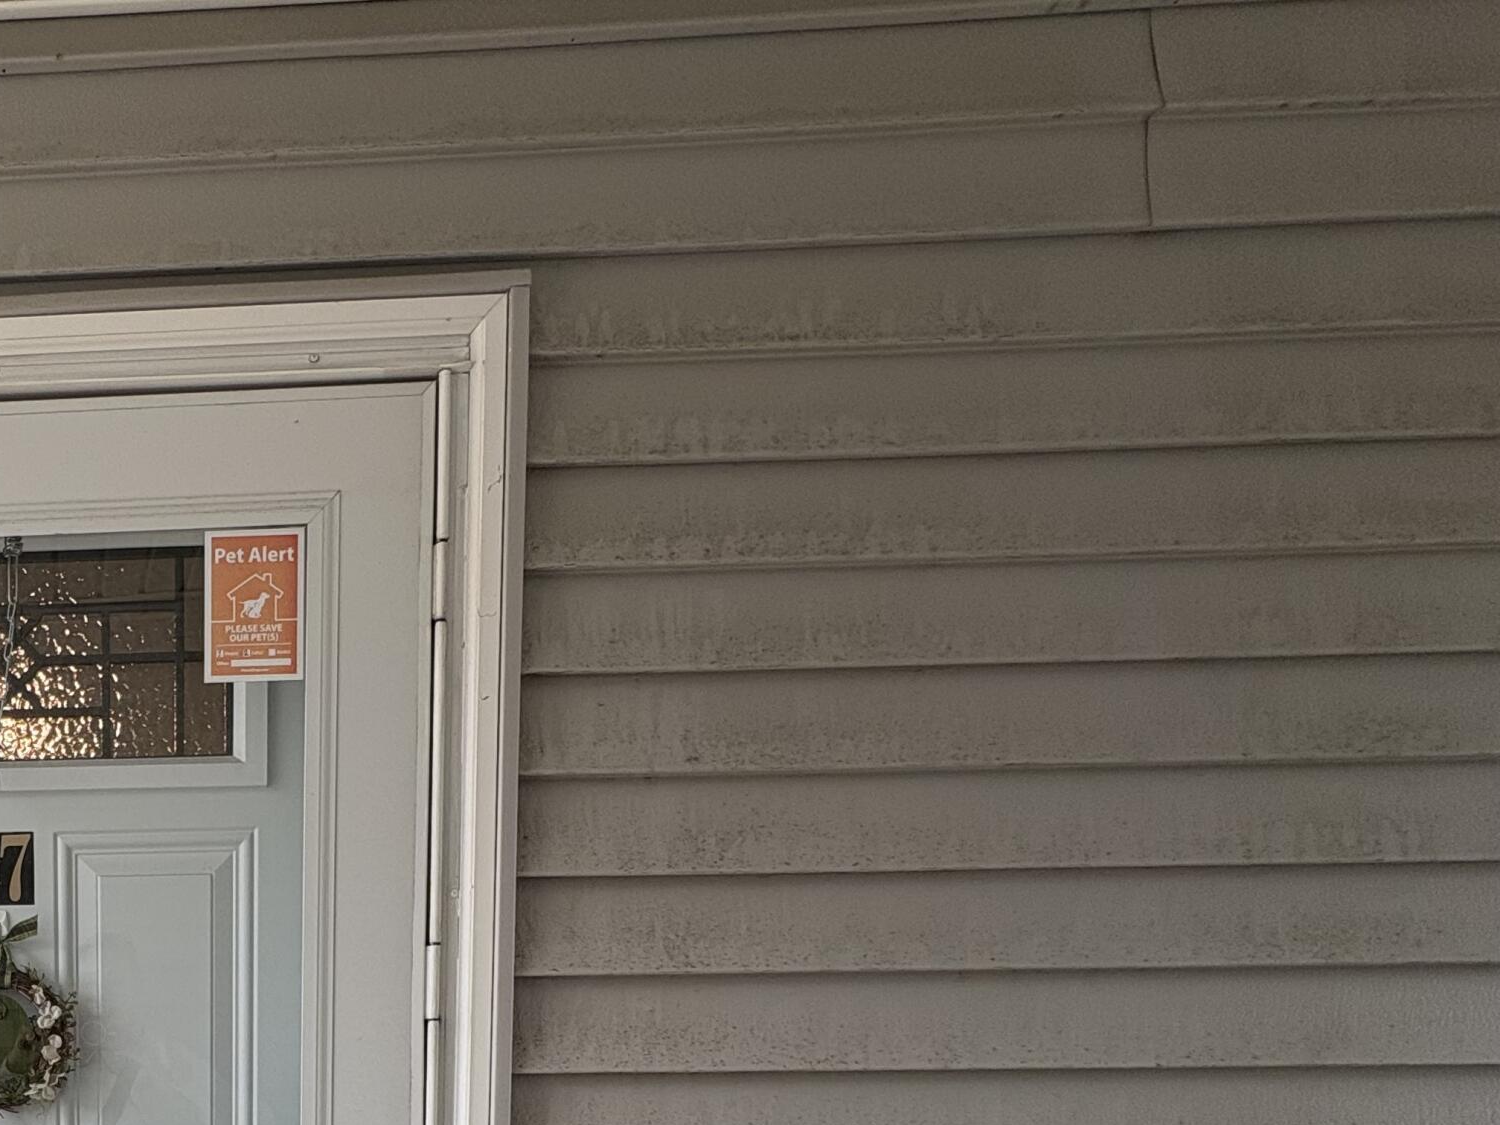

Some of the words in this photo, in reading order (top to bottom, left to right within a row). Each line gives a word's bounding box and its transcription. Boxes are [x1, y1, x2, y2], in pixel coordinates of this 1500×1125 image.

[215, 547, 244, 564] Pet
[249, 546, 294, 563] Alert
[225, 624, 258, 633] PLEASE
[260, 623, 282, 632] SAVE
[229, 634, 249, 642] OUR
[251, 633, 279, 642] PET(S)
